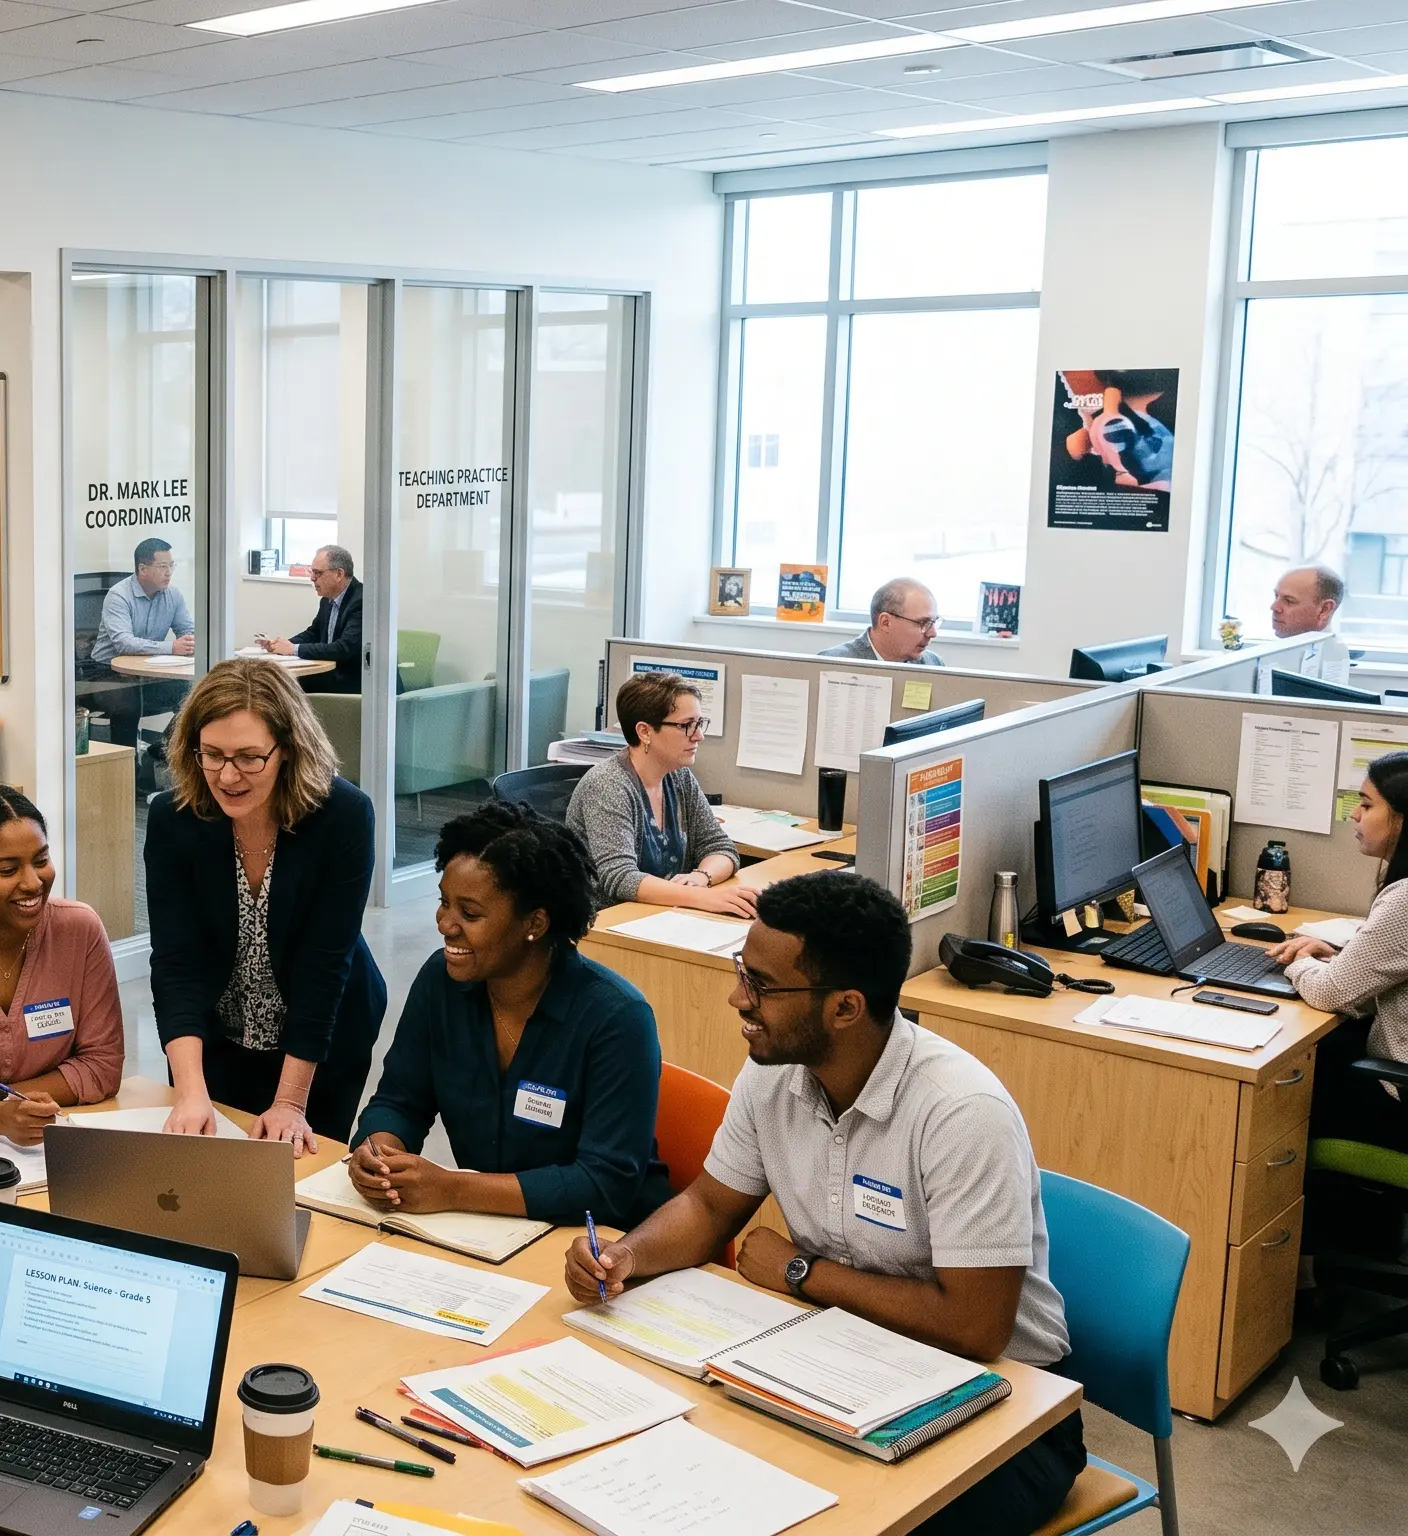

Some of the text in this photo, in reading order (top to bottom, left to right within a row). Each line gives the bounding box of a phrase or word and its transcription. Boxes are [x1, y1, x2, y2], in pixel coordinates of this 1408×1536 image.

[398, 467, 509, 487] TEACHING PRACTICE
[88, 479, 189, 502] DR. MARK LEE
[416, 490, 491, 509] DEPARTMENT
[85, 504, 191, 529] COORDINATOR
[25, 1267, 57, 1283] LESSON
[119, 1289, 144, 1303] Grade
[145, 1295, 151, 1304] 5
